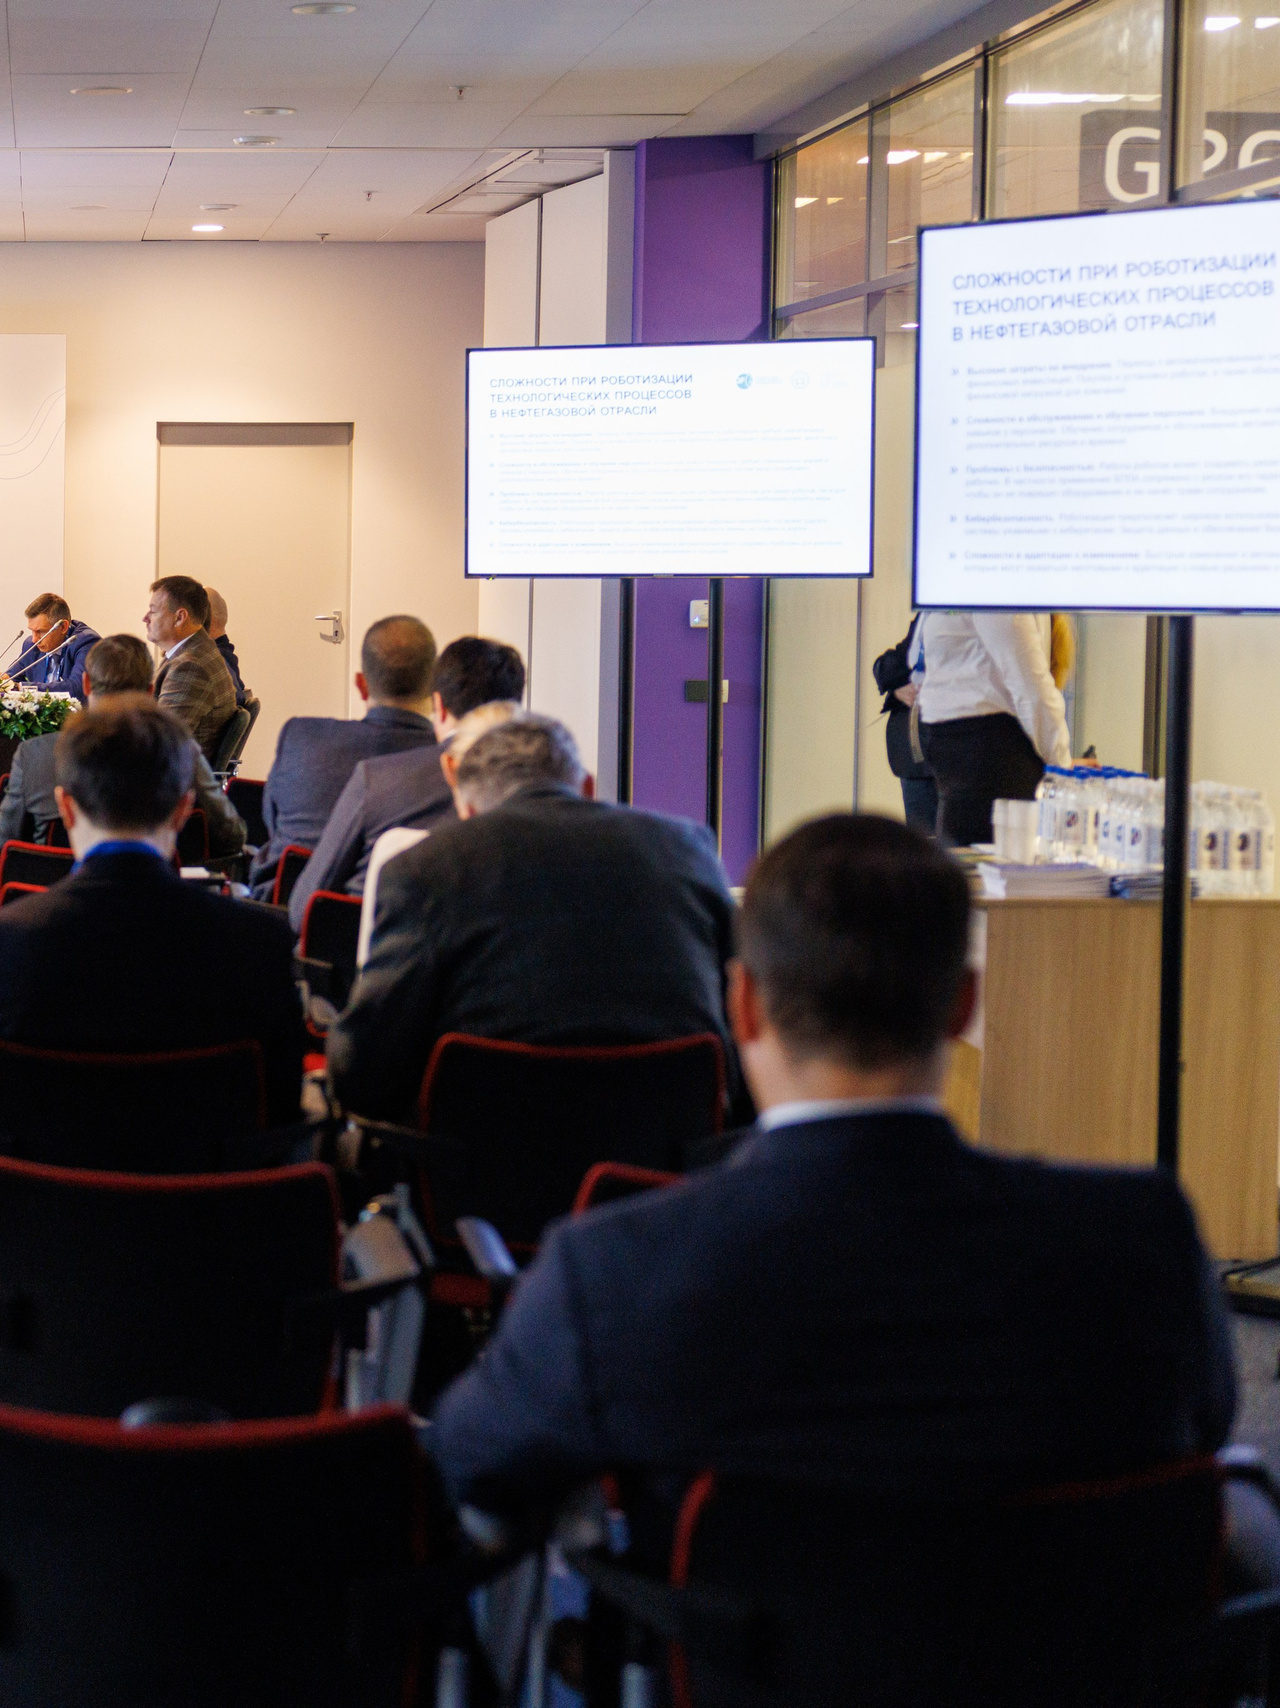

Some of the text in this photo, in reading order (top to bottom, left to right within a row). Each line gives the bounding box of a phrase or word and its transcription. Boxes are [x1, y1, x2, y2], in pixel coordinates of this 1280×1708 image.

[953, 252, 1277, 291] СЛОЖНОСТИ ПРИ РОБОТИЗАЦИИ
[953, 281, 1274, 316] ТЕХНОЛОГИЧЕСКИХ ПРОЦЕССОВ
[953, 312, 1216, 341] В НЕФТЕГАЗОВОЙ ОТРАСЛИ
[490, 373, 693, 388] СЛОЖНОСТИ ПРИ РОБОТИЗАЦИИ
[490, 388, 692, 403] ТЕХНОЛОГИЧЕСКИХ ПРОЦЕССОВ
[490, 405, 657, 418] В НЕФТЕГАЗОВОЙ ОТРАСЛИ
